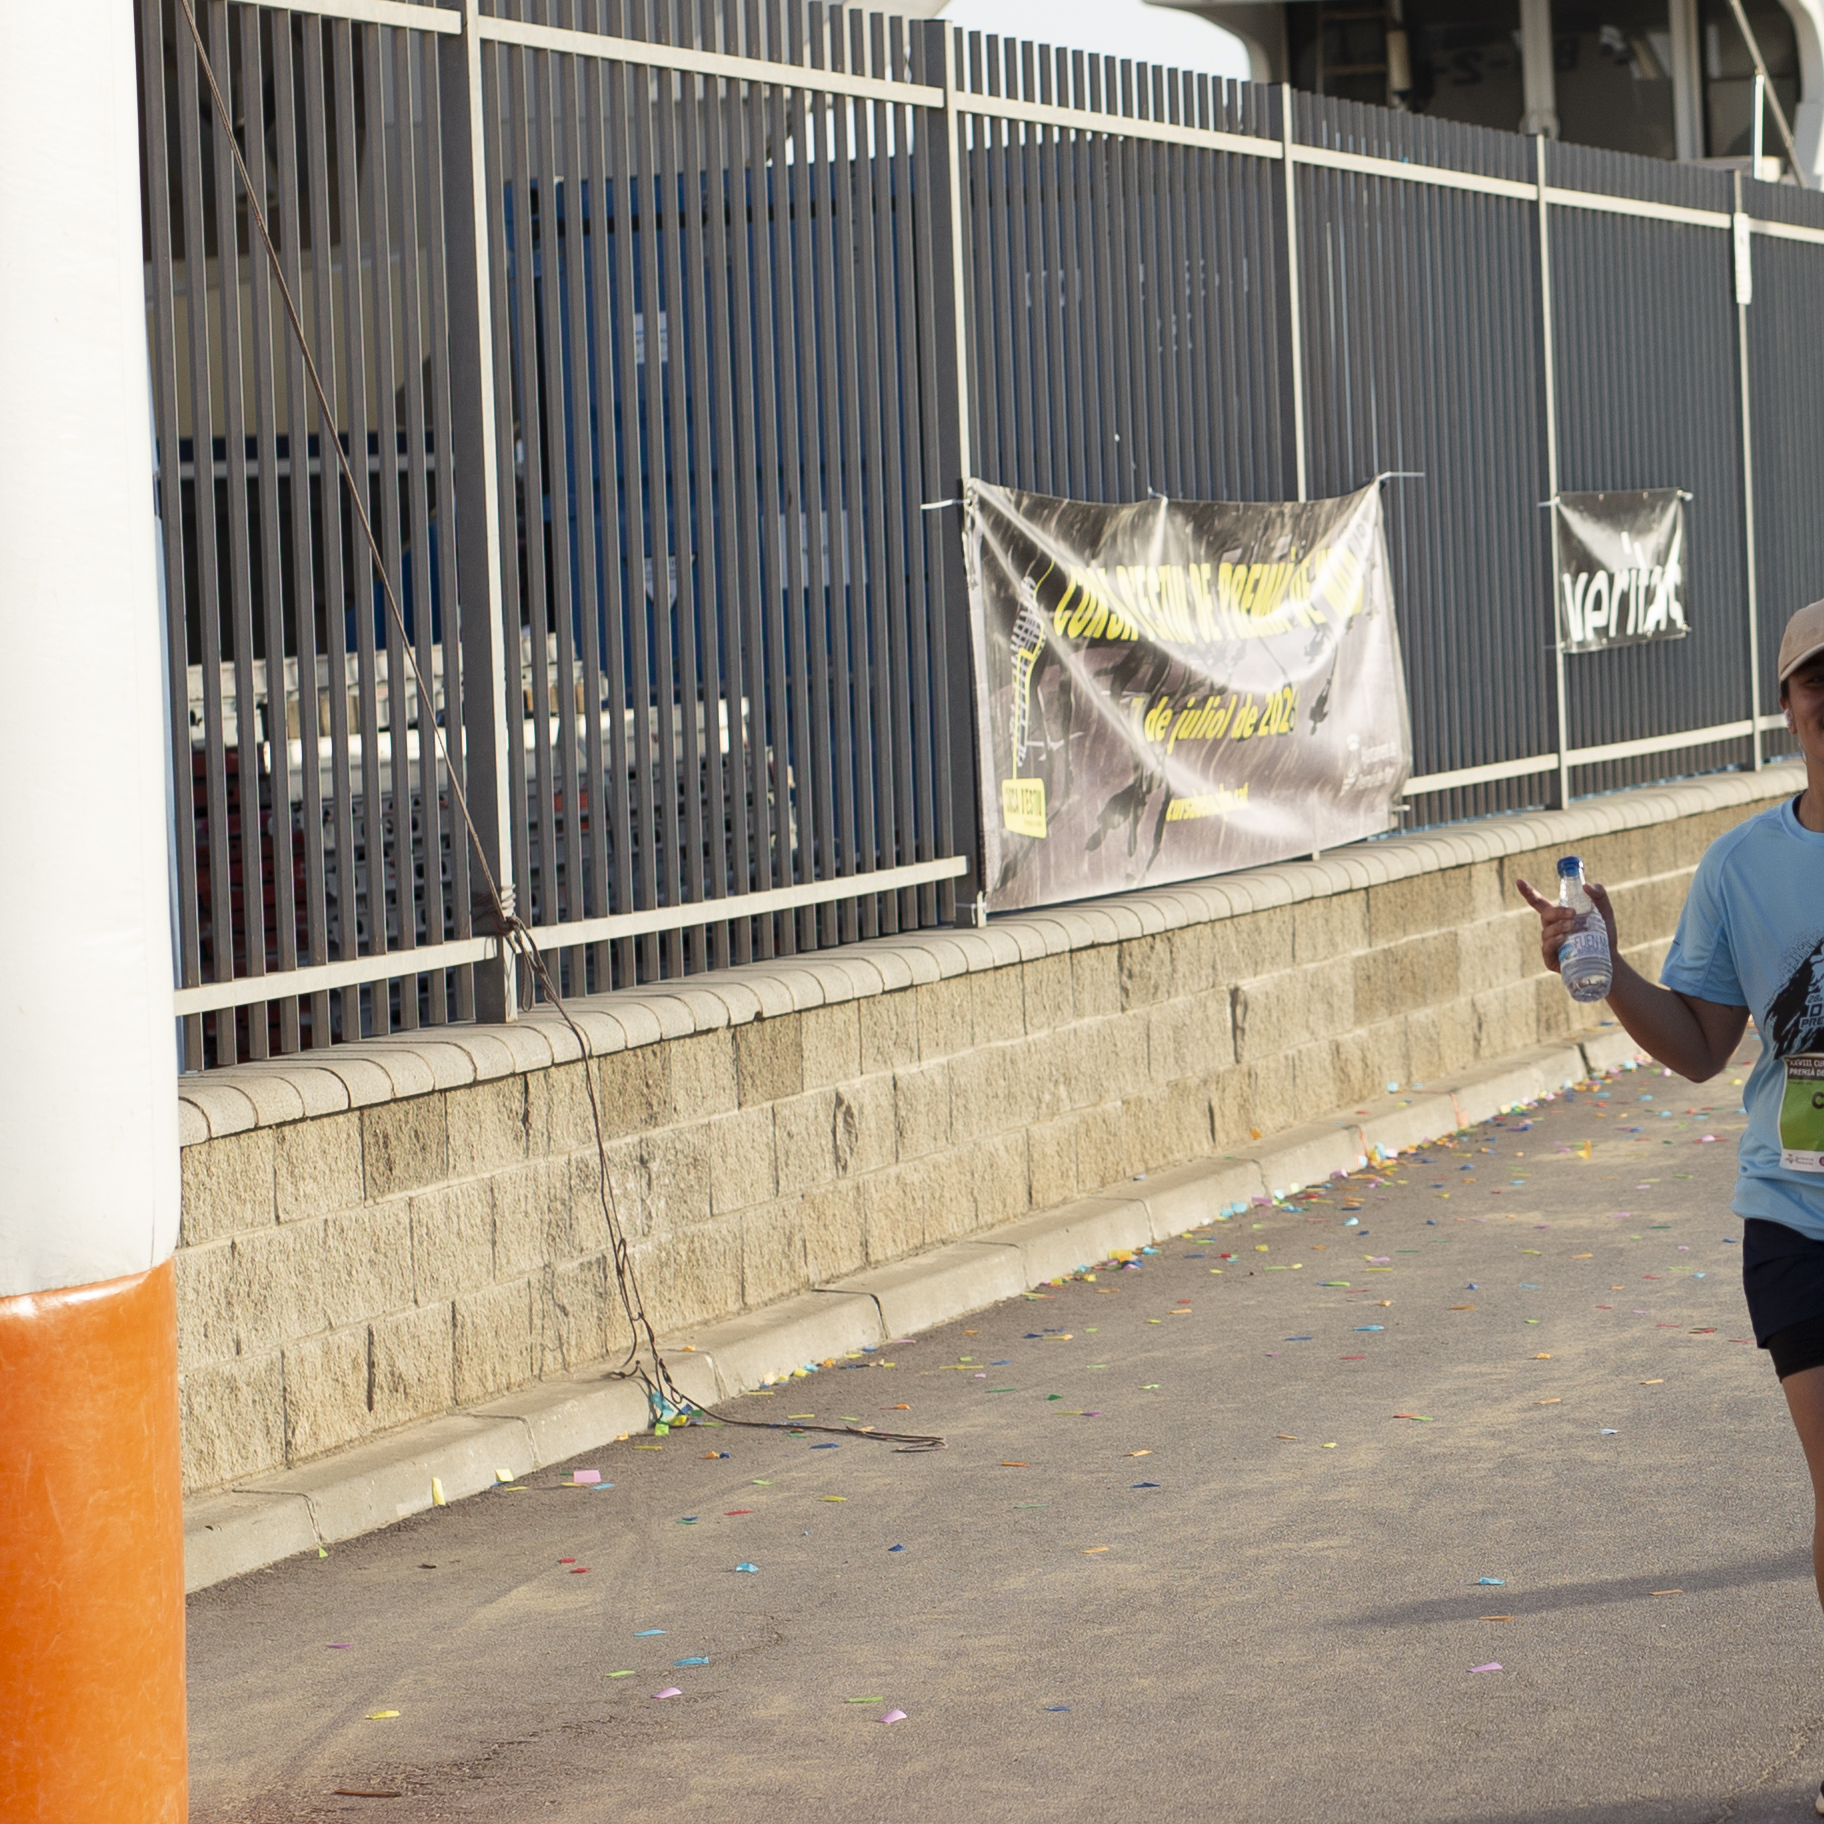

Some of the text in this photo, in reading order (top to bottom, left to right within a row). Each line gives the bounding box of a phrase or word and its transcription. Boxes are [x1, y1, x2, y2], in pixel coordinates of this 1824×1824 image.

[1189, 562, 1224, 644] DE
[1144, 695, 1174, 743] de
[1166, 694, 1238, 755] juliol
[1231, 692, 1259, 739] de
[1789, 1067, 1815, 1076] PREMIÀ
